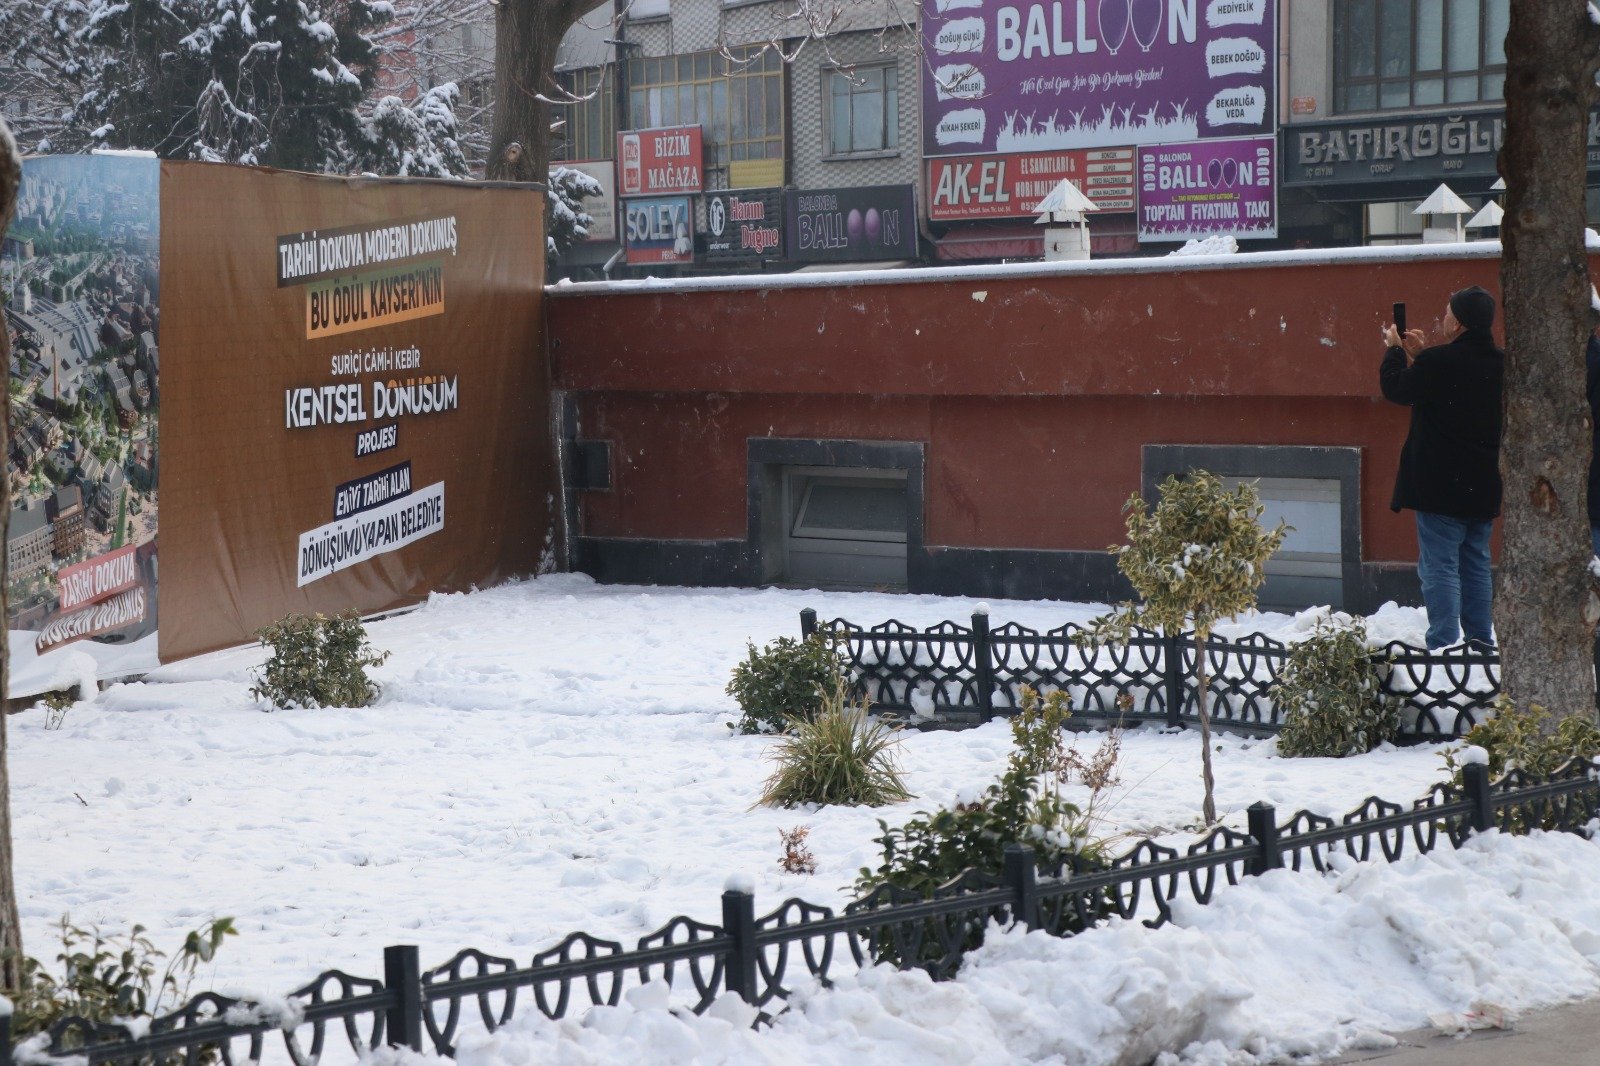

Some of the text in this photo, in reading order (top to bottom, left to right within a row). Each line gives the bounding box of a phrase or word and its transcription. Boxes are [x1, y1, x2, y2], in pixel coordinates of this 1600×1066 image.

[1217, 2, 1254, 14] HEDİYELİK
[940, 29, 981, 44] DOĞUM GÜNÜ
[1211, 50, 1260, 65] BEBEK DOĞDU
[1216, 94, 1255, 108] BEKARLIĞA
[1226, 108, 1245, 118] VEDA
[940, 120, 981, 133] NİKAH ŞEKERİ
[655, 132, 690, 158] BİZİM
[1160, 153, 1191, 163] BALONDA
[648, 162, 700, 189] MAĞAZA
[1021, 156, 1075, 174] EL SANATLARI &
[1370, 163, 1394, 176] ÇORAP
[1442, 160, 1463, 170] MAYO
[934, 161, 1010, 206] AK-EL
[798, 194, 838, 212] BALONDA
[1144, 201, 1270, 221] TOPTAN FİYATINA TAKI
[627, 204, 684, 241] SOLEY
[280, 216, 457, 279] TARİHİ DOKUYA MODERN DOKUNUŞ
[741, 224, 778, 254] Düğme
[311, 266, 442, 331] BU ÖDÜL KAYSERİ'NİN
[331, 344, 421, 378] SURİÇİ CÂMİ-İ KEBİR
[286, 383, 367, 429] KENTSEL
[357, 424, 397, 456] PROJESİ
[363, 473, 389, 506] TARİHİ
[390, 466, 410, 496] ALAN
[361, 512, 399, 552] YAPAN
[401, 495, 442, 539] BELEDİYE
[60, 552, 135, 608] TARİHİ DOKUYA
[94, 585, 145, 631] DOKUNUŞ
